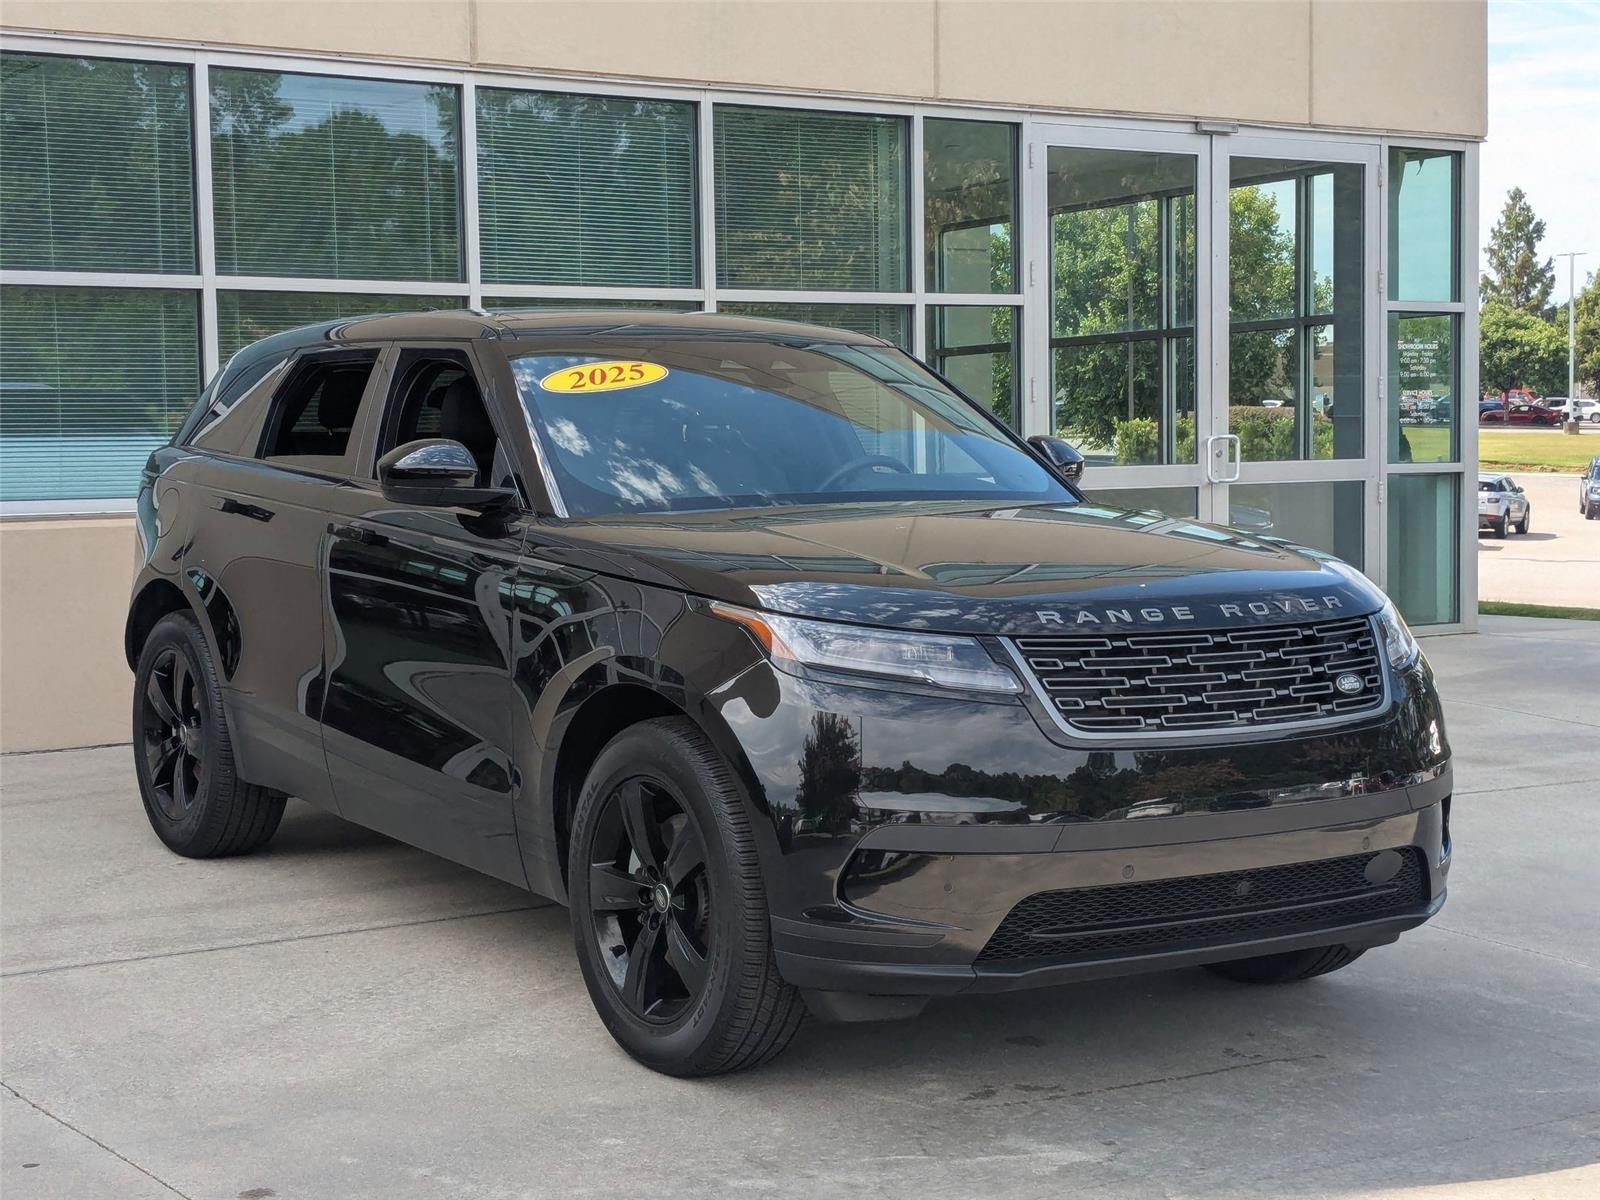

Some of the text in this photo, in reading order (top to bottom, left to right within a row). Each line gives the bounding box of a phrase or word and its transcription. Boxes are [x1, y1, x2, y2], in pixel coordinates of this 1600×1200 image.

[568, 364, 645, 390] 2025
[1035, 595, 1344, 625] RANGE ROVER
